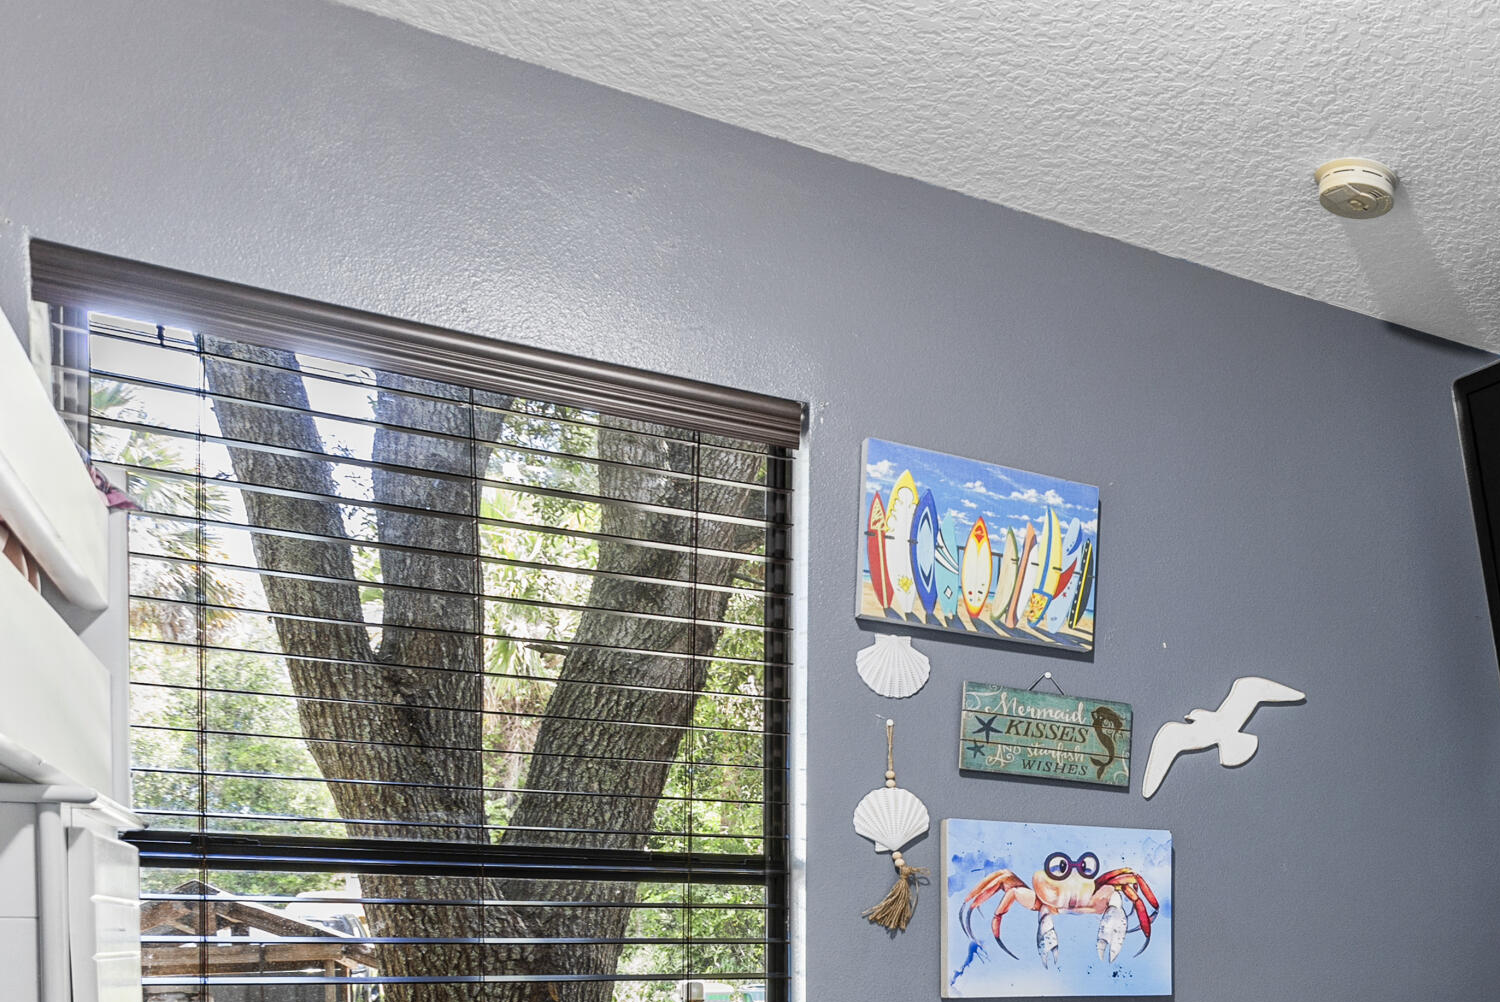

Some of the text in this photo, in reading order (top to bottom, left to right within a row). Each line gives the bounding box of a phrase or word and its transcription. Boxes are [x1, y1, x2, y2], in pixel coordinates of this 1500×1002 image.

[985, 691, 1086, 725] Mermaid
[1004, 719, 1090, 744] KISSES
[985, 742, 1086, 767] AND starfish
[1021, 758, 1089, 776] WISHES
